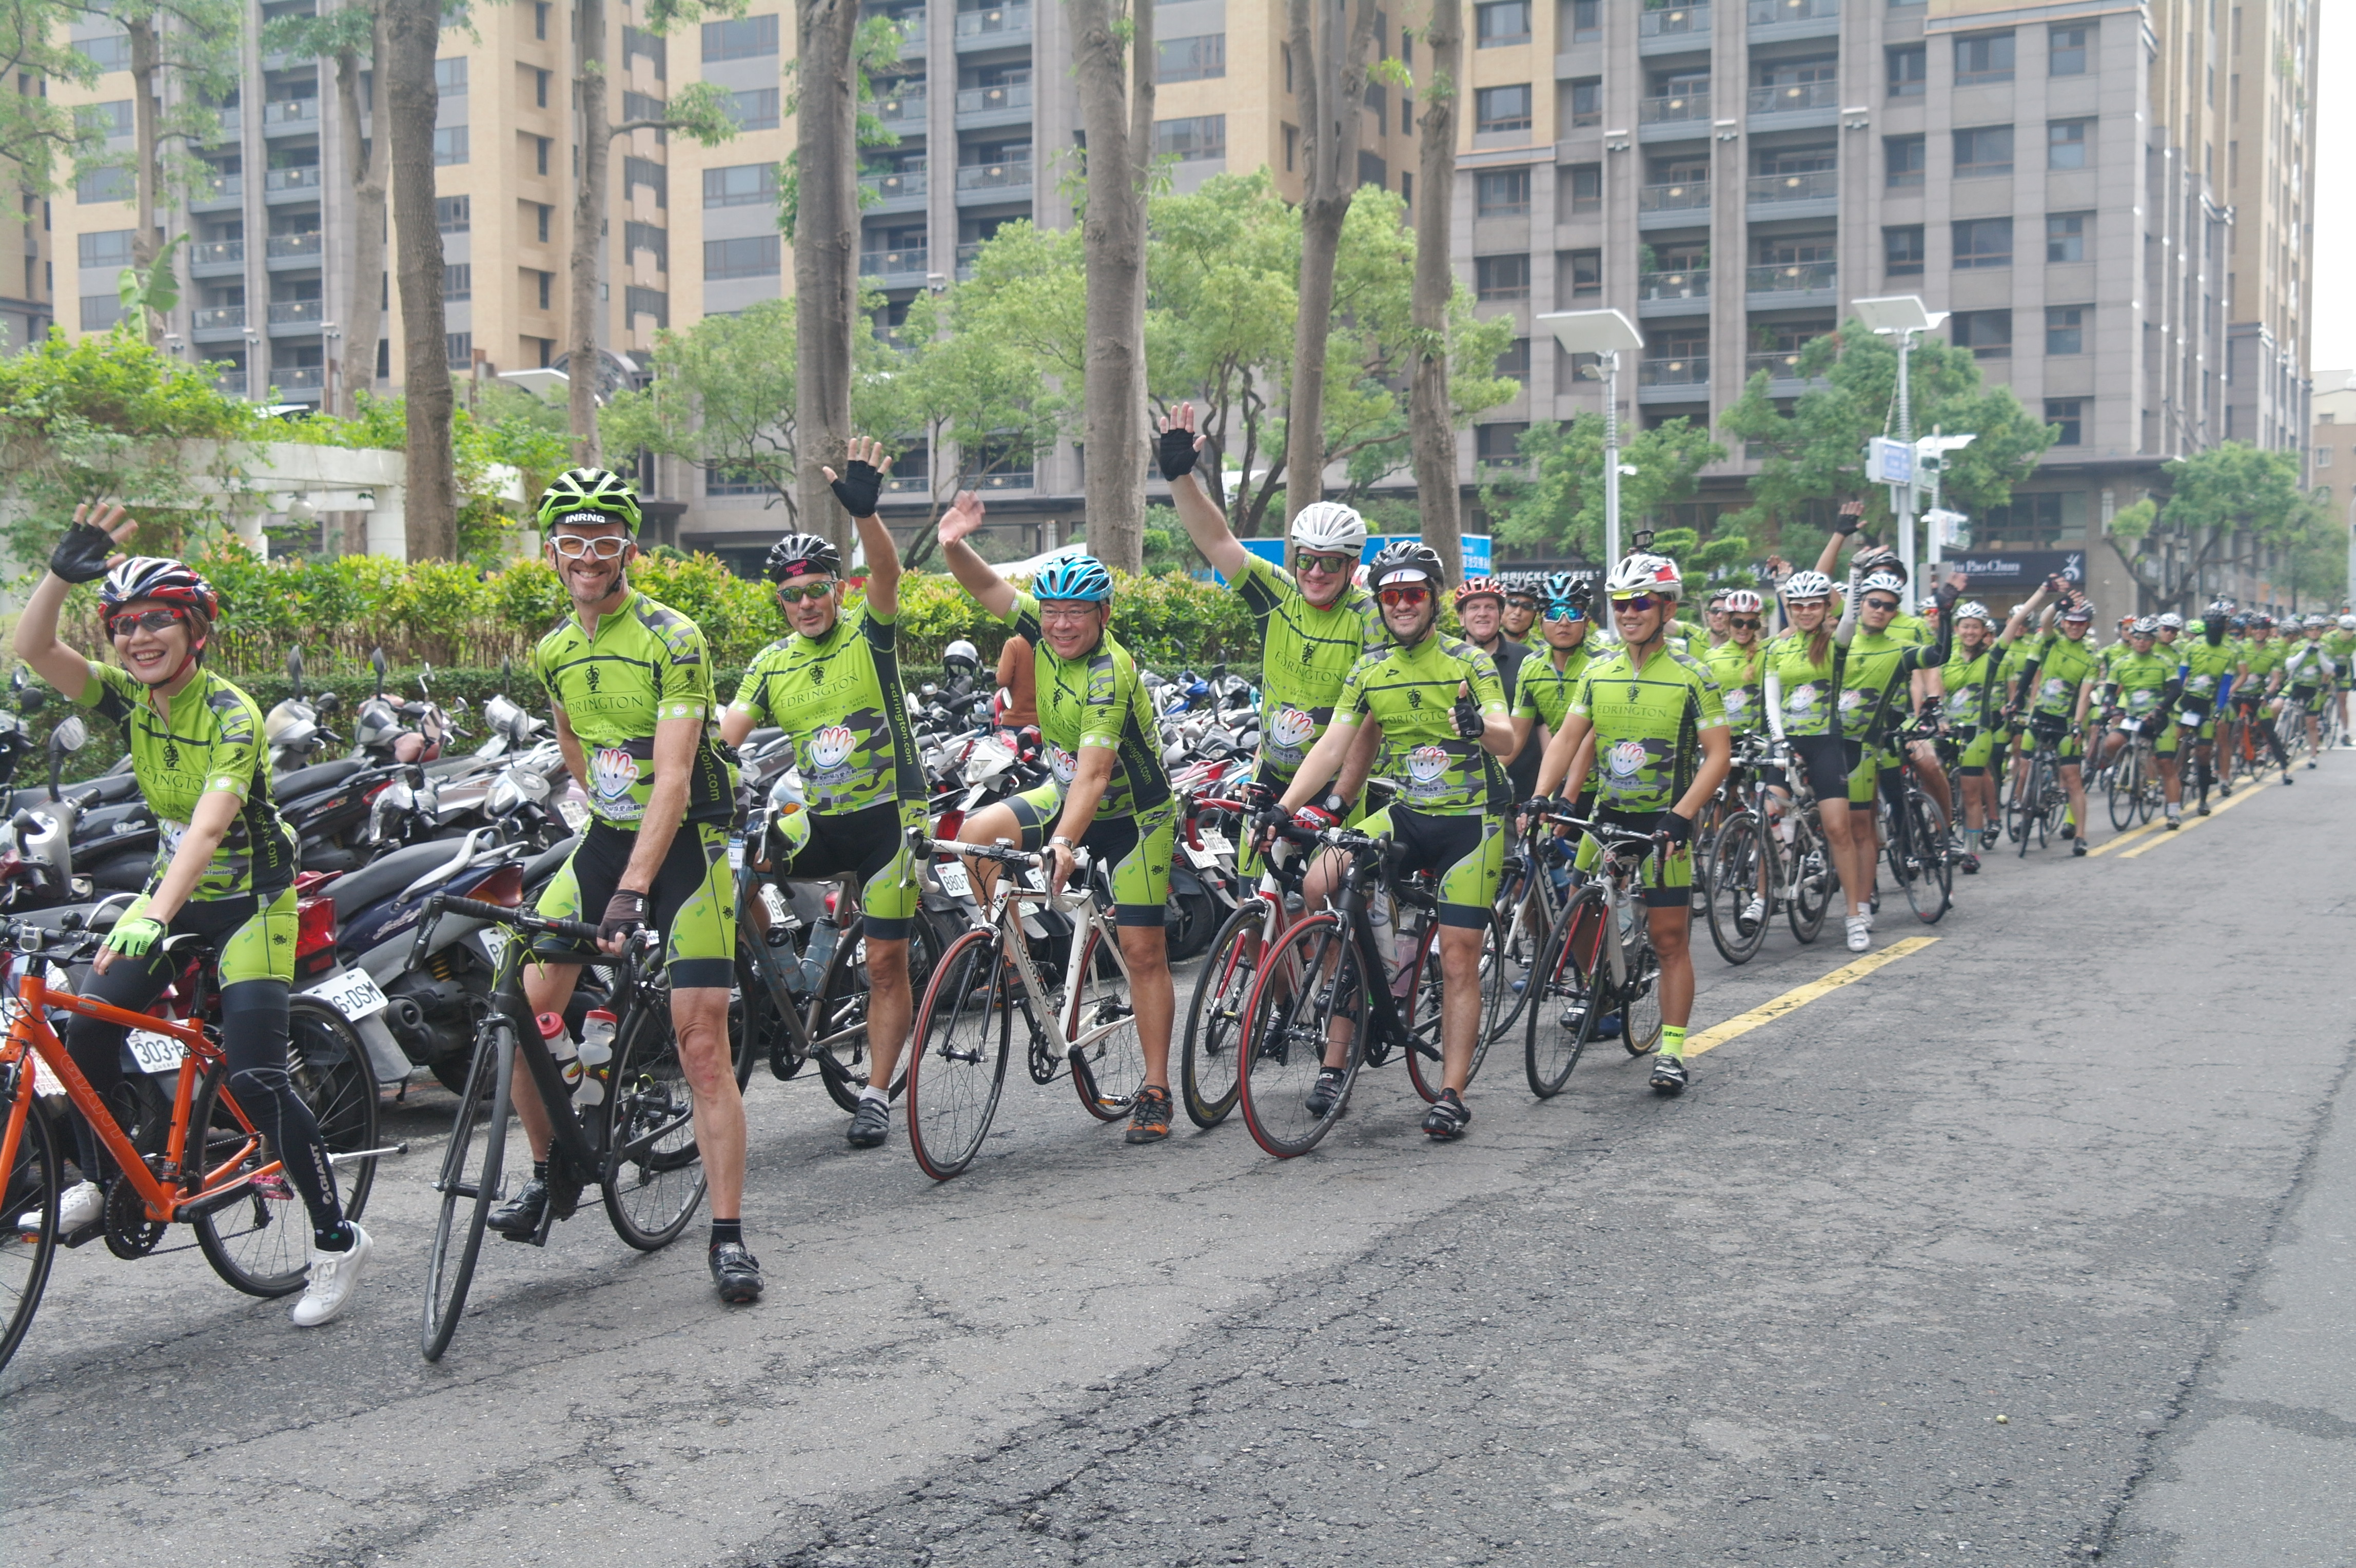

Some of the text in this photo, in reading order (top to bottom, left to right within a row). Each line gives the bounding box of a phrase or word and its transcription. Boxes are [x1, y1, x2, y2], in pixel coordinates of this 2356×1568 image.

[565, 513, 605, 523] INRNG
[793, 568, 804, 577] PINK
[1966, 559, 1987, 572] Pao
[1987, 559, 2020, 572] Chun
[1275, 651, 1343, 682] EDRINGTON
[780, 672, 859, 709] EDRINGTON
[849, 693, 869, 704] GIVING
[852, 699, 869, 708] MORE
[1382, 710, 1447, 724] EDRINGTO
[1597, 705, 1667, 718] EDRINGTON
[889, 682, 913, 765] edrington.com
[1082, 718, 1122, 728] EDRINGTON
[1122, 736, 1152, 786] edrington.com
[136, 755, 204, 792] EINGTO
[60, 1054, 123, 1139] GIANT
[309, 1143, 329, 1191] GIANT
